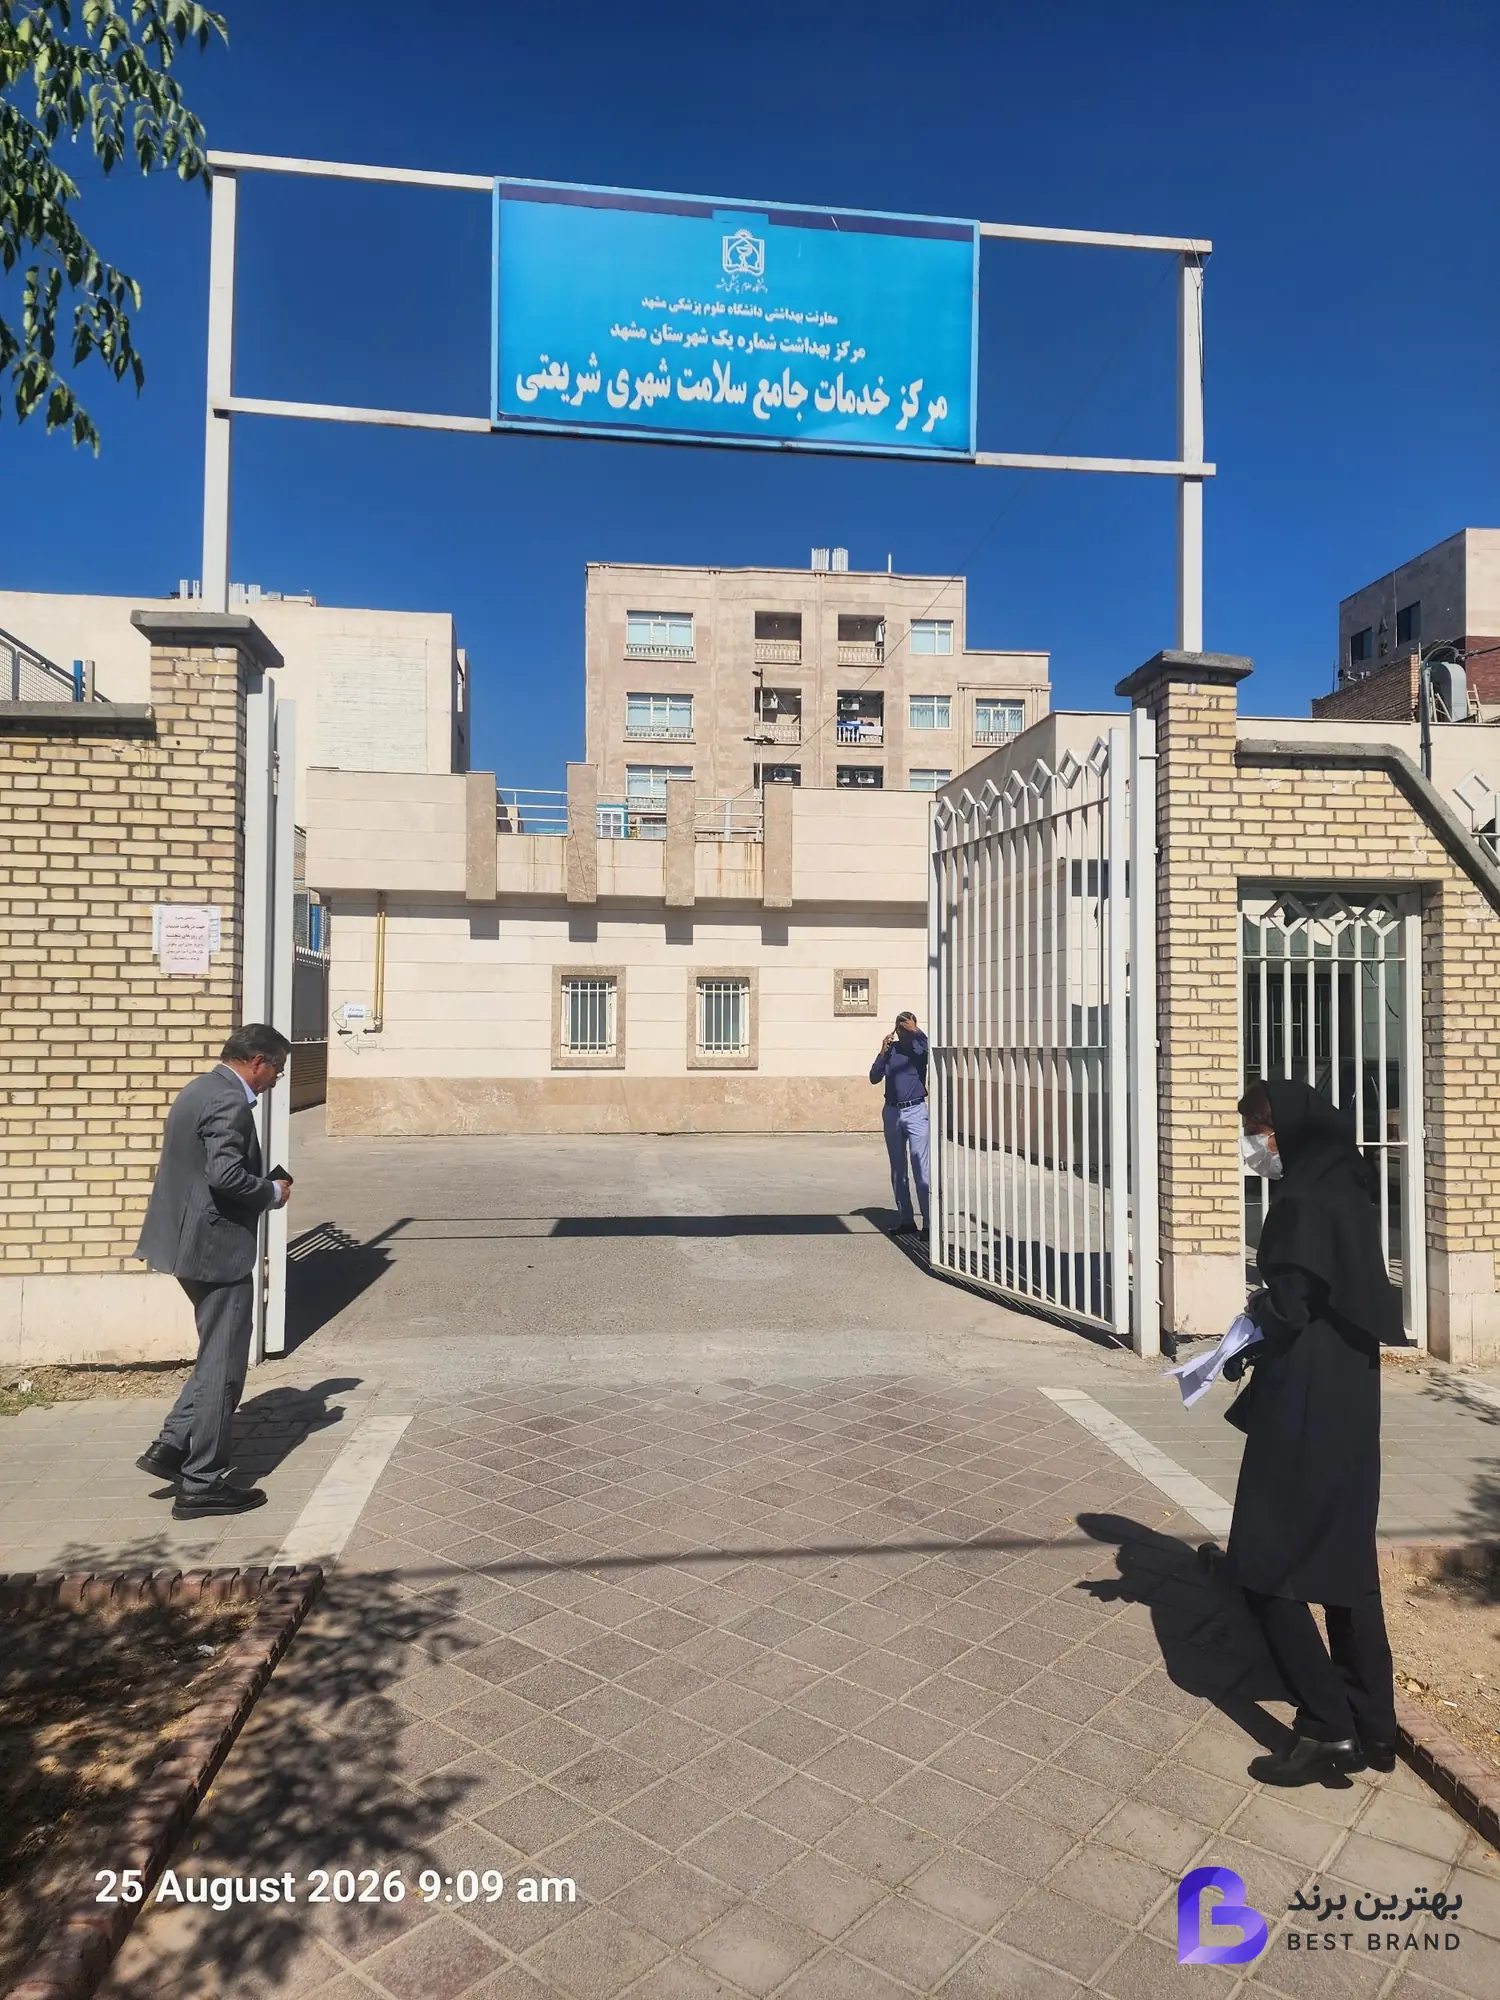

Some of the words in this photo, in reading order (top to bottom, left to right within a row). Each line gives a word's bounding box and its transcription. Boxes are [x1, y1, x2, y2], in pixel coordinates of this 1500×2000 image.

[641, 296, 667, 311] مشهد
[668, 298, 702, 315] پزشکی
[703, 301, 726, 317] علوم
[727, 302, 763, 317] دانشگاه
[765, 307, 803, 324] بهداشتی
[805, 311, 838, 327] معاونت
[610, 321, 647, 342] مشهد
[650, 323, 709, 348] شهرستان
[711, 329, 734, 352] یک
[735, 332, 777, 354] شماره
[780, 337, 830, 360] بهداشت
[833, 340, 866, 363] مرکز
[516, 352, 601, 406] شریعتی
[606, 357, 671, 410] شهری
[677, 359, 747, 404] سلامت
[753, 367, 809, 422] جامع
[814, 372, 890, 415] خدمات
[895, 378, 948, 432] مرکز
